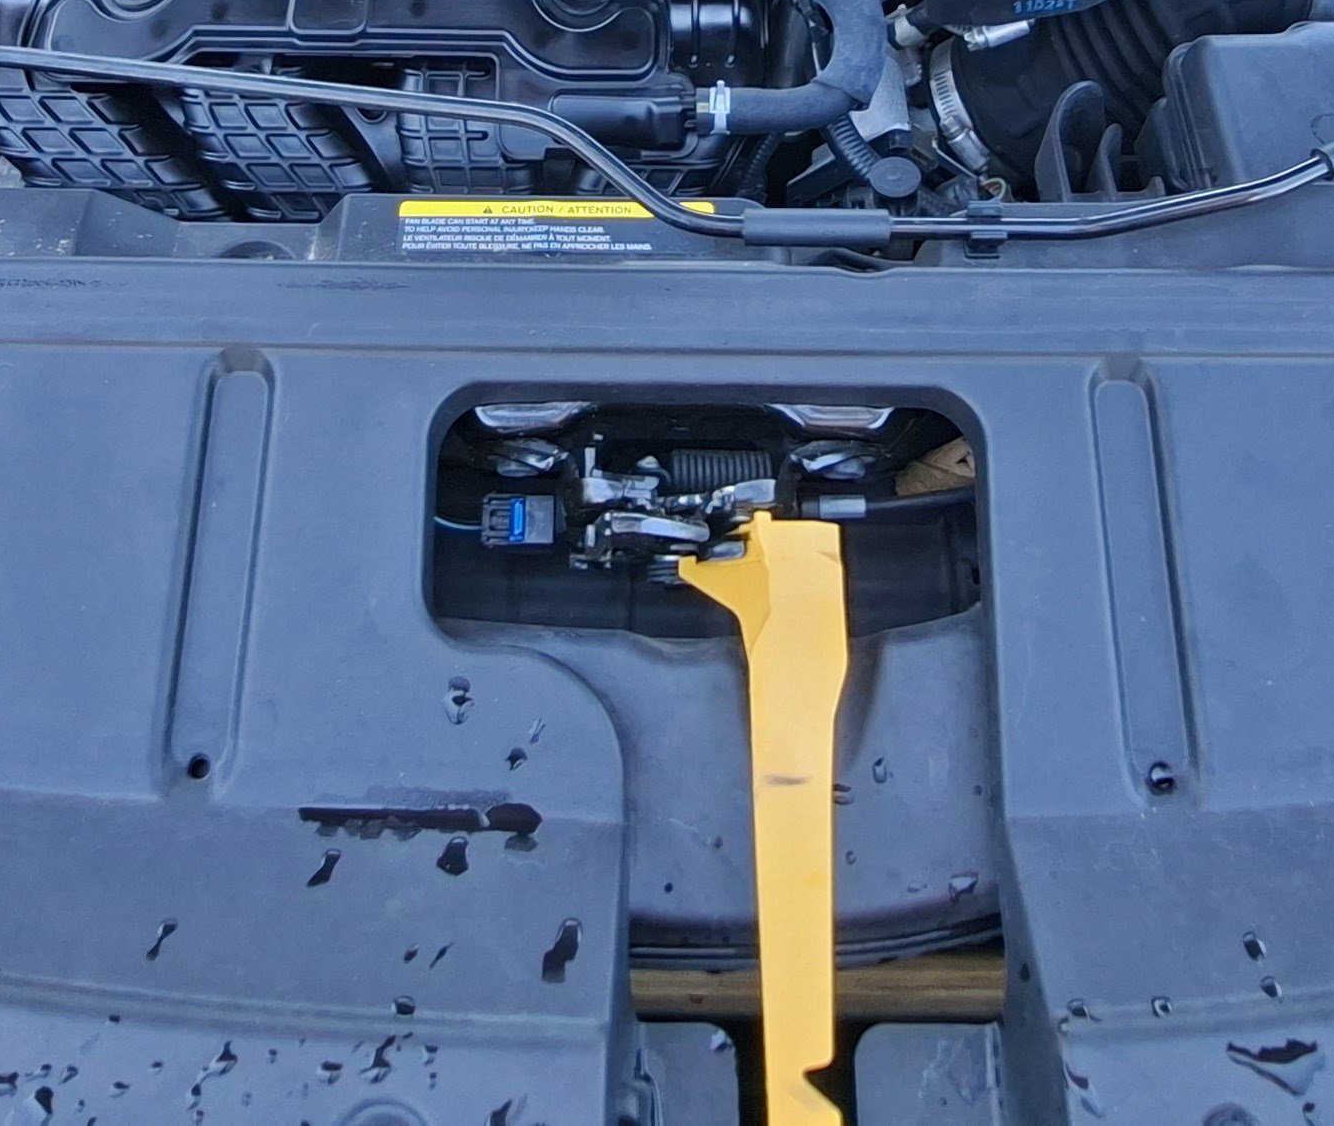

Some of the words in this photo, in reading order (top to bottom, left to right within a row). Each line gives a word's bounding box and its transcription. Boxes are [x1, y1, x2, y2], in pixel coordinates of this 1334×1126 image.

[501, 205, 554, 215] CAUTION
[567, 205, 632, 215] ATTENTION
[461, 225, 501, 233] PERSONAL
[550, 225, 576, 233] HANDS
[463, 234, 492, 242] RISQUE
[555, 234, 575, 242] TOUT
[533, 242, 549, 250] PAS
